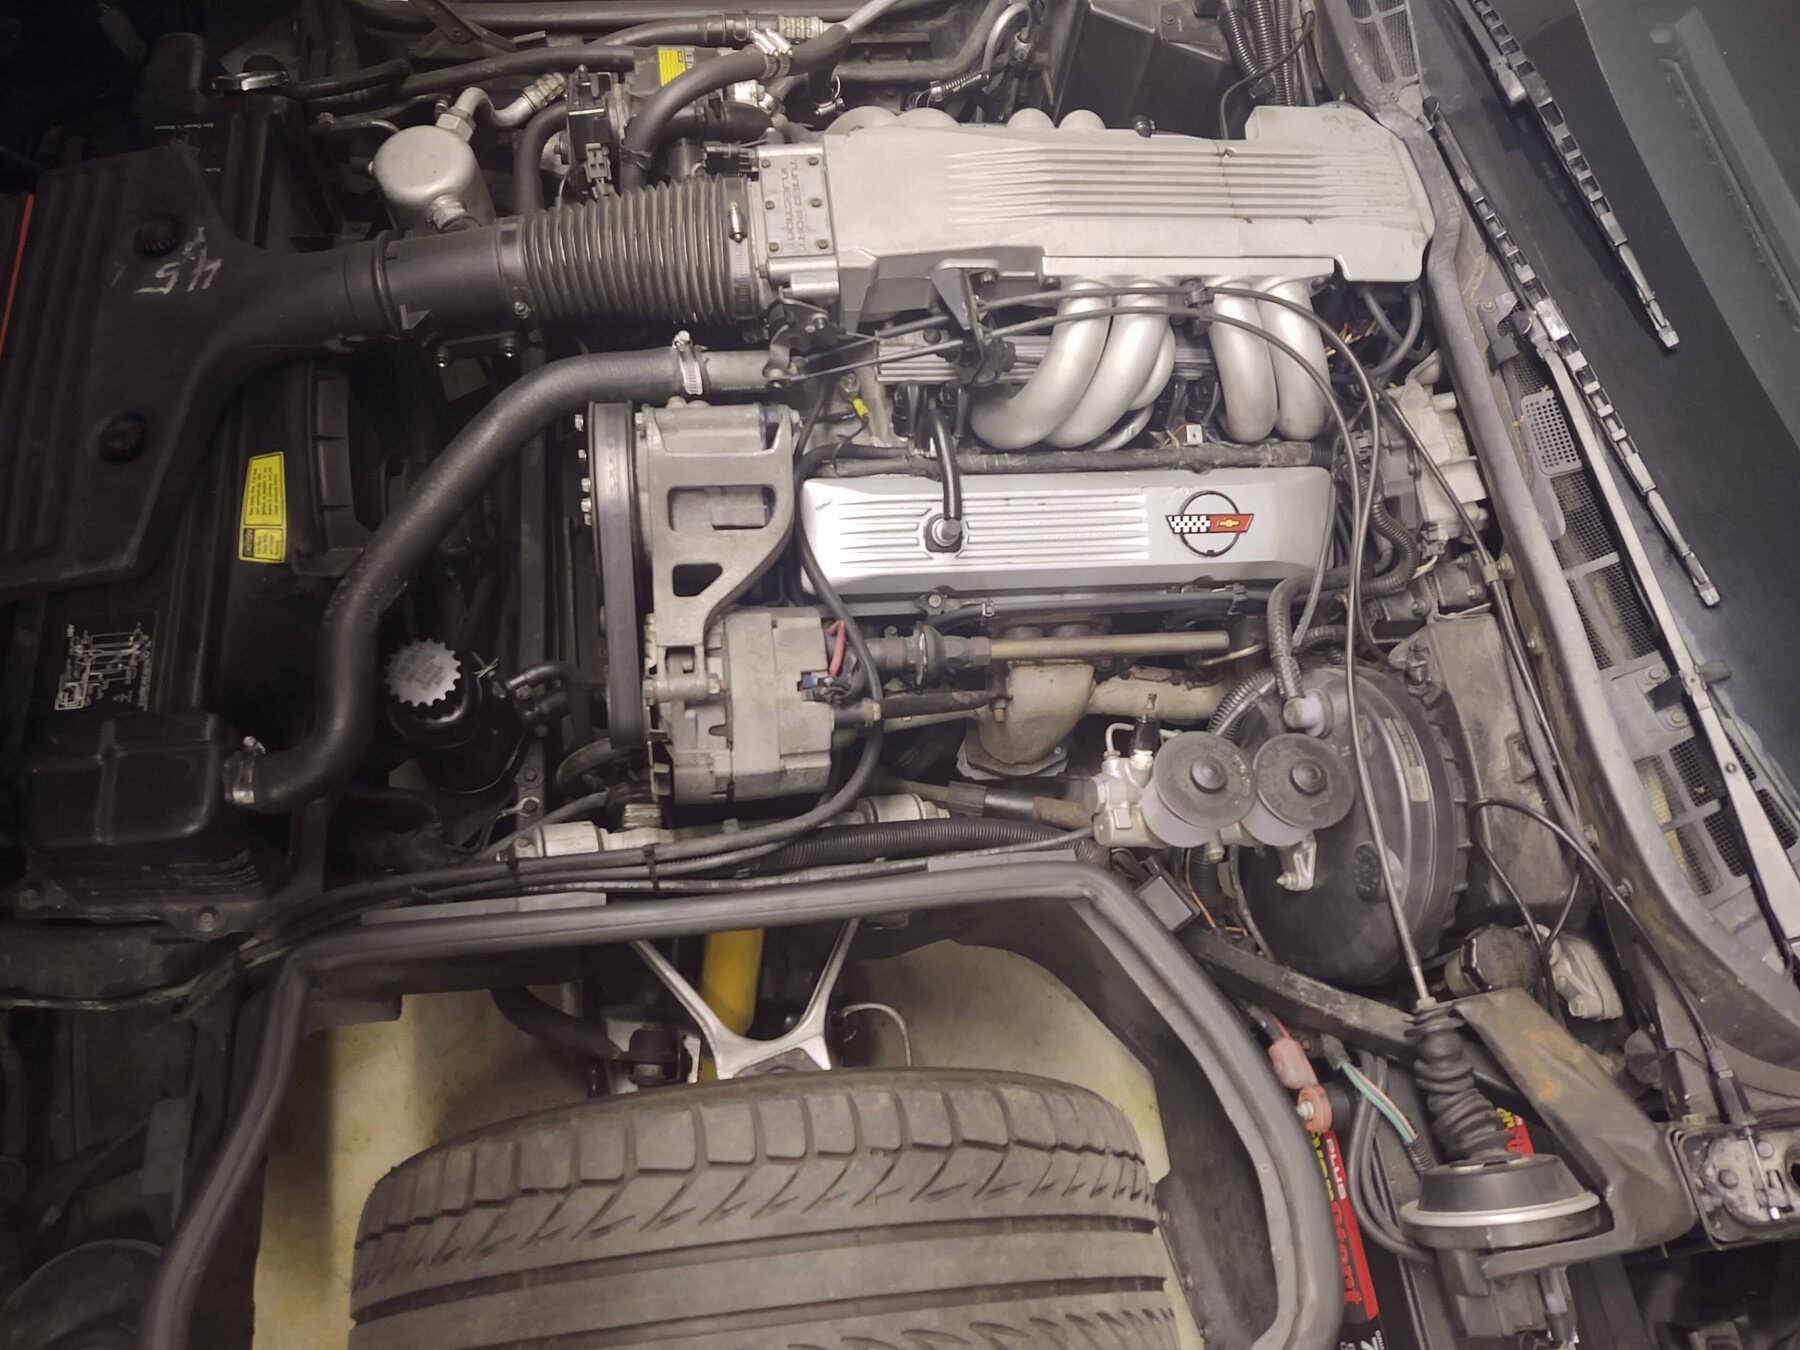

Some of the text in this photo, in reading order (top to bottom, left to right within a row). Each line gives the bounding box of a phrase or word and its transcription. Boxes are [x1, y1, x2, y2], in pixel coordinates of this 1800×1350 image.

[781, 167, 795, 241] INJECTION
[789, 159, 807, 248] TUNED PORT
[1326, 1138, 1347, 1200] PLUS
